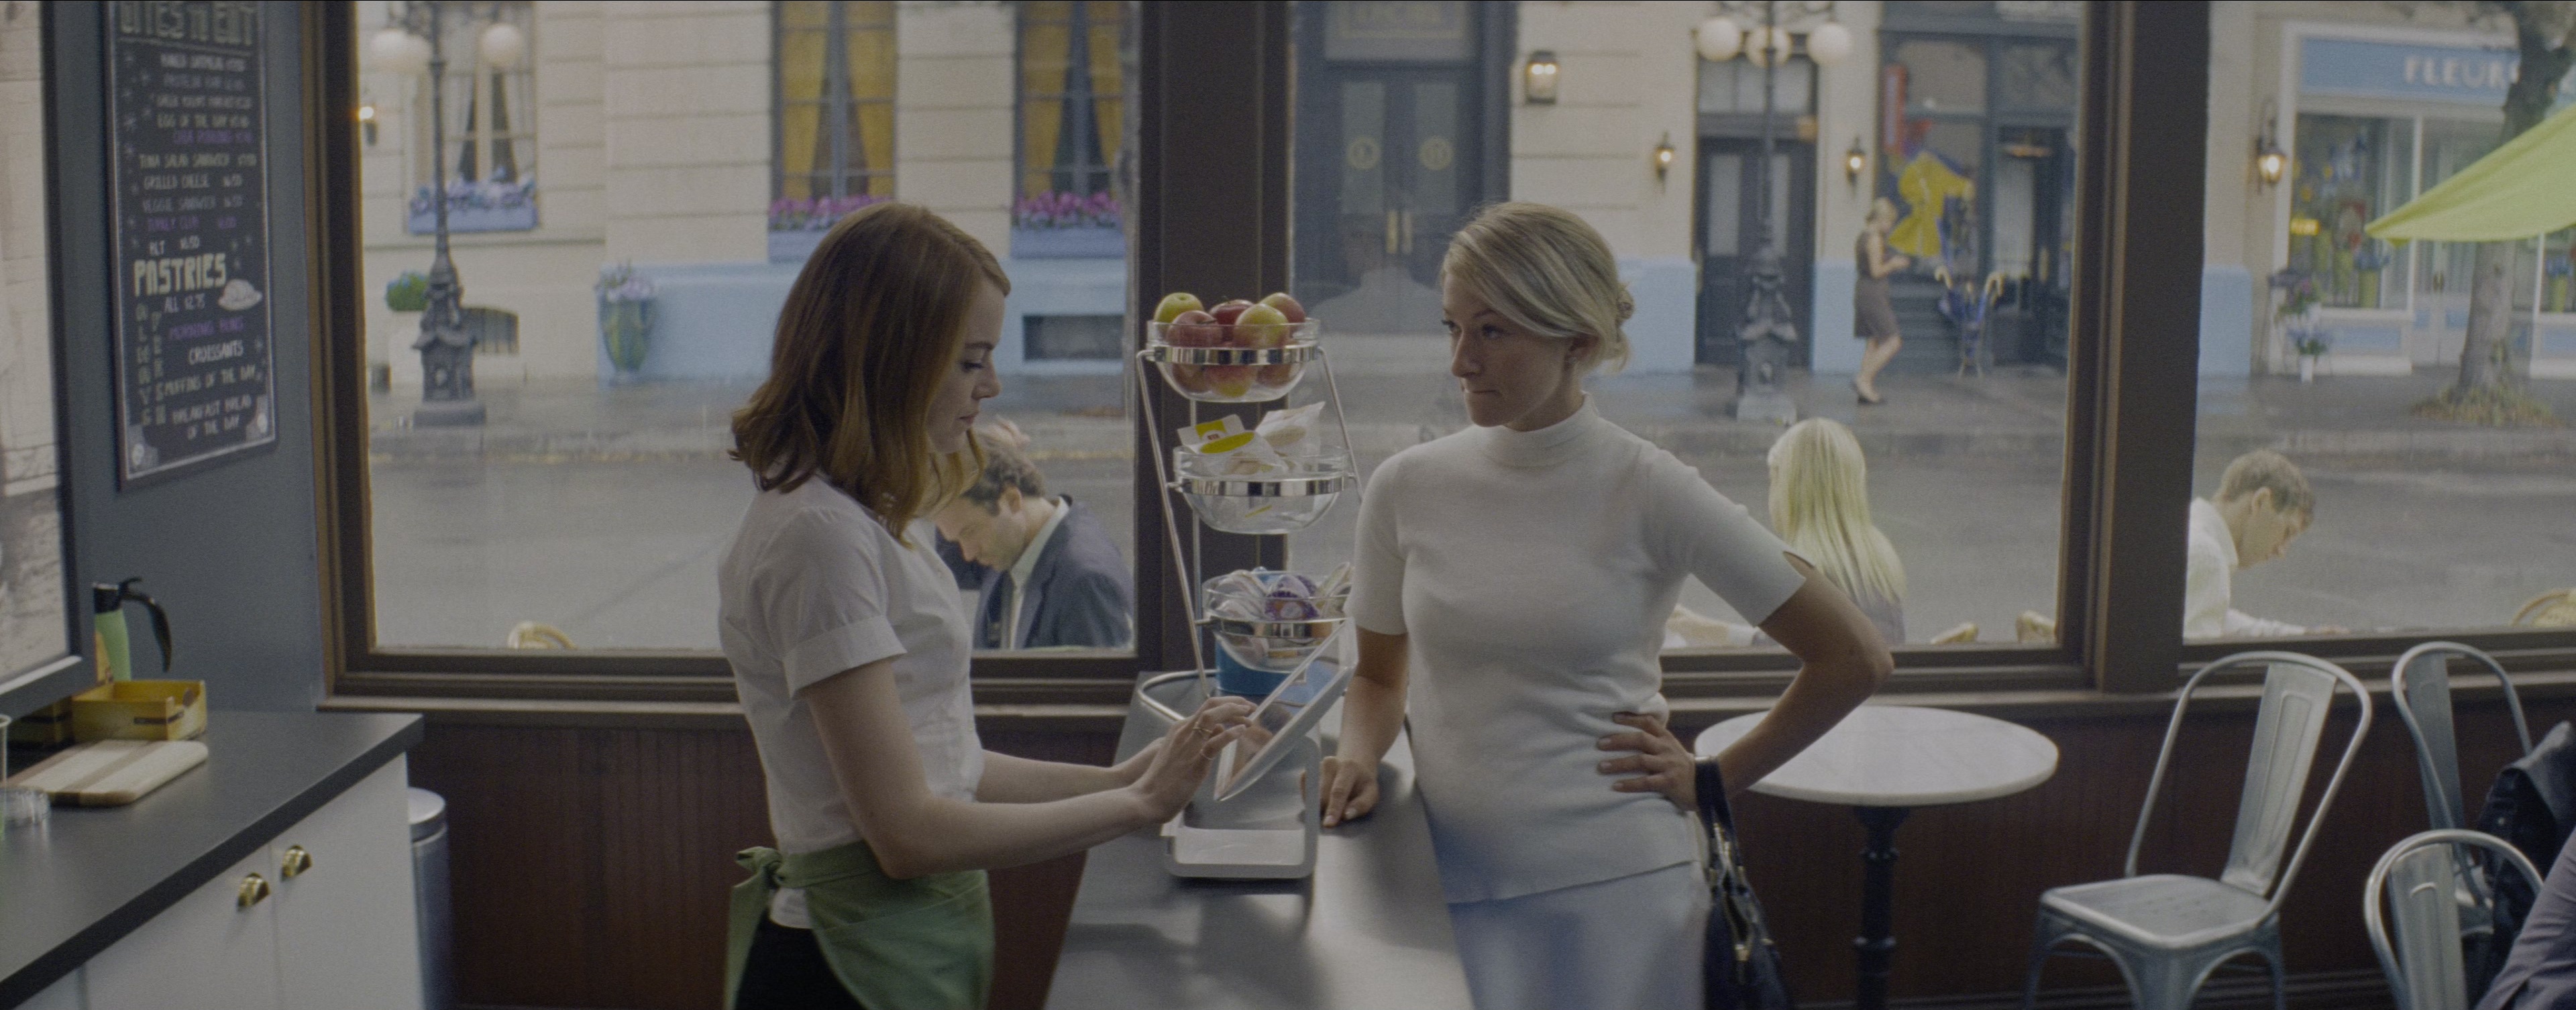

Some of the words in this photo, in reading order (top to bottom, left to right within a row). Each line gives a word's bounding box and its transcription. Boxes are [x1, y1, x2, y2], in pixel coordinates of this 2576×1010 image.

[133, 252, 227, 297] PASTRIES
[189, 339, 244, 365] CROISSANTS
[220, 367, 235, 384] THE
[240, 364, 256, 381] DAY
[204, 420, 219, 435] THE
[224, 415, 239, 431] DAY
